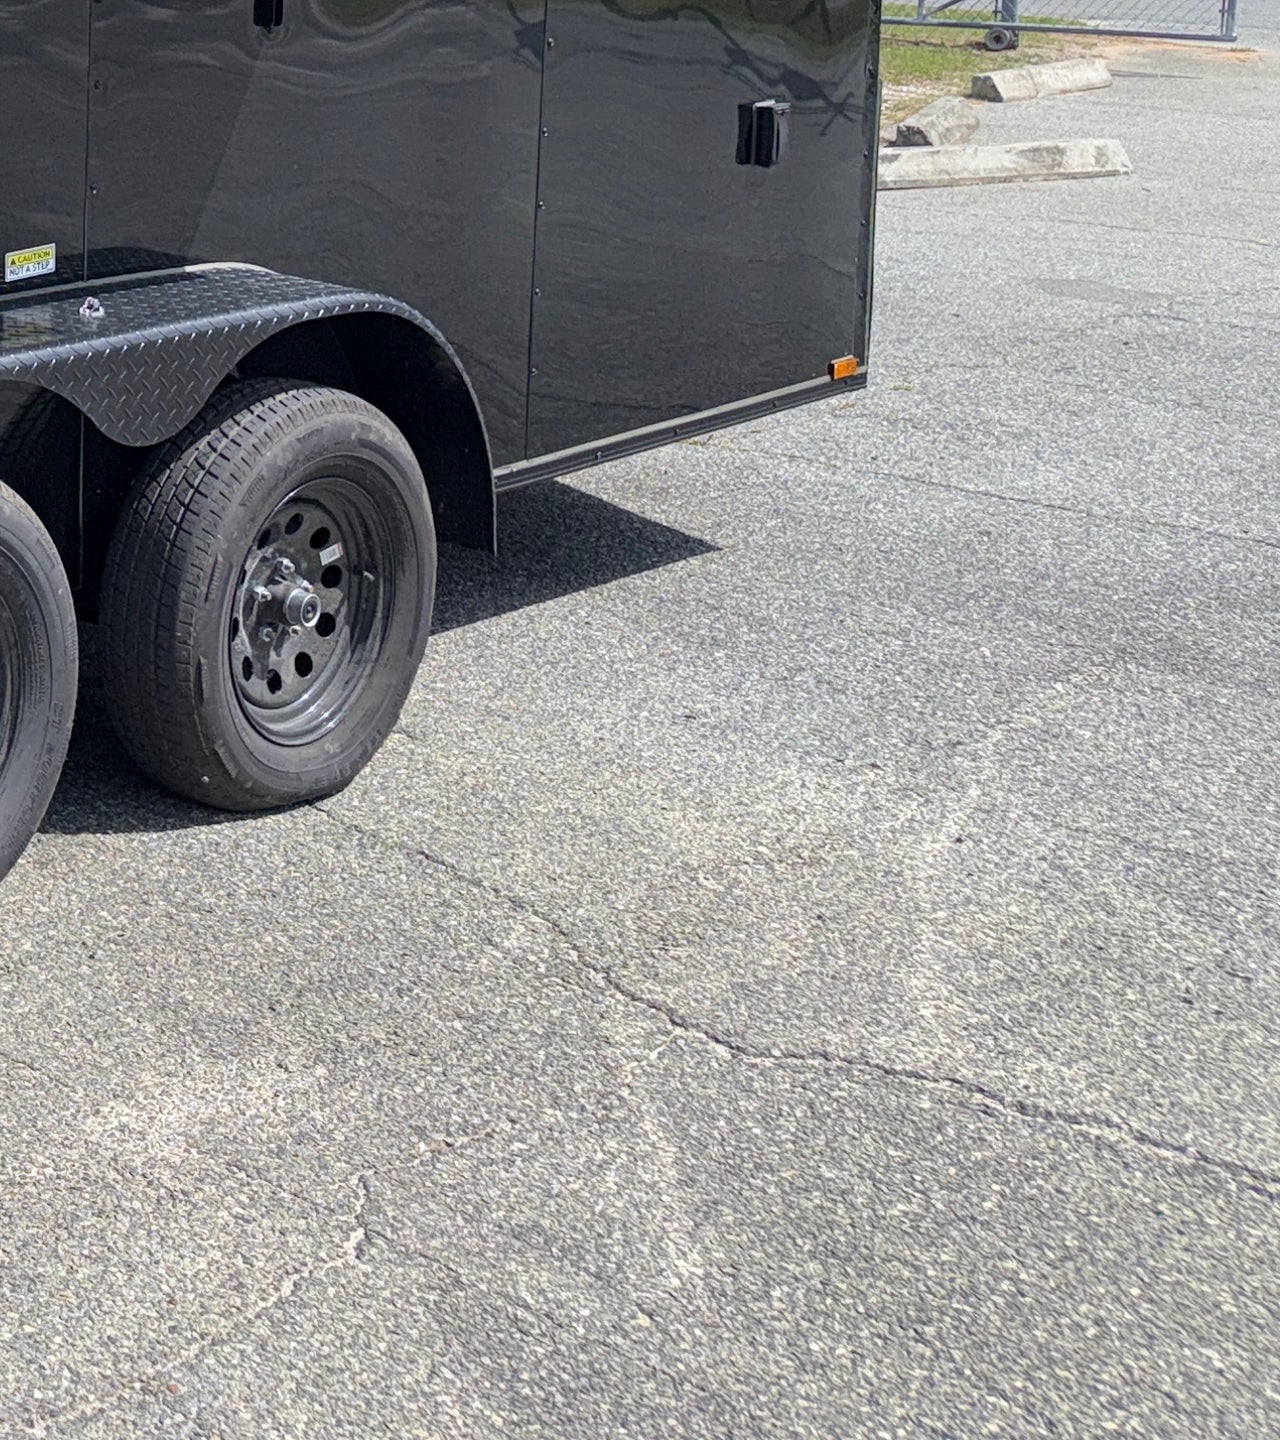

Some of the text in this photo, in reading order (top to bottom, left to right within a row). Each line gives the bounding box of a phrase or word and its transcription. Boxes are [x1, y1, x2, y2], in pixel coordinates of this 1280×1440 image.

[17, 250, 50, 264] CAUTION
[9, 265, 24, 277] NOT
[33, 261, 50, 273] STEP
